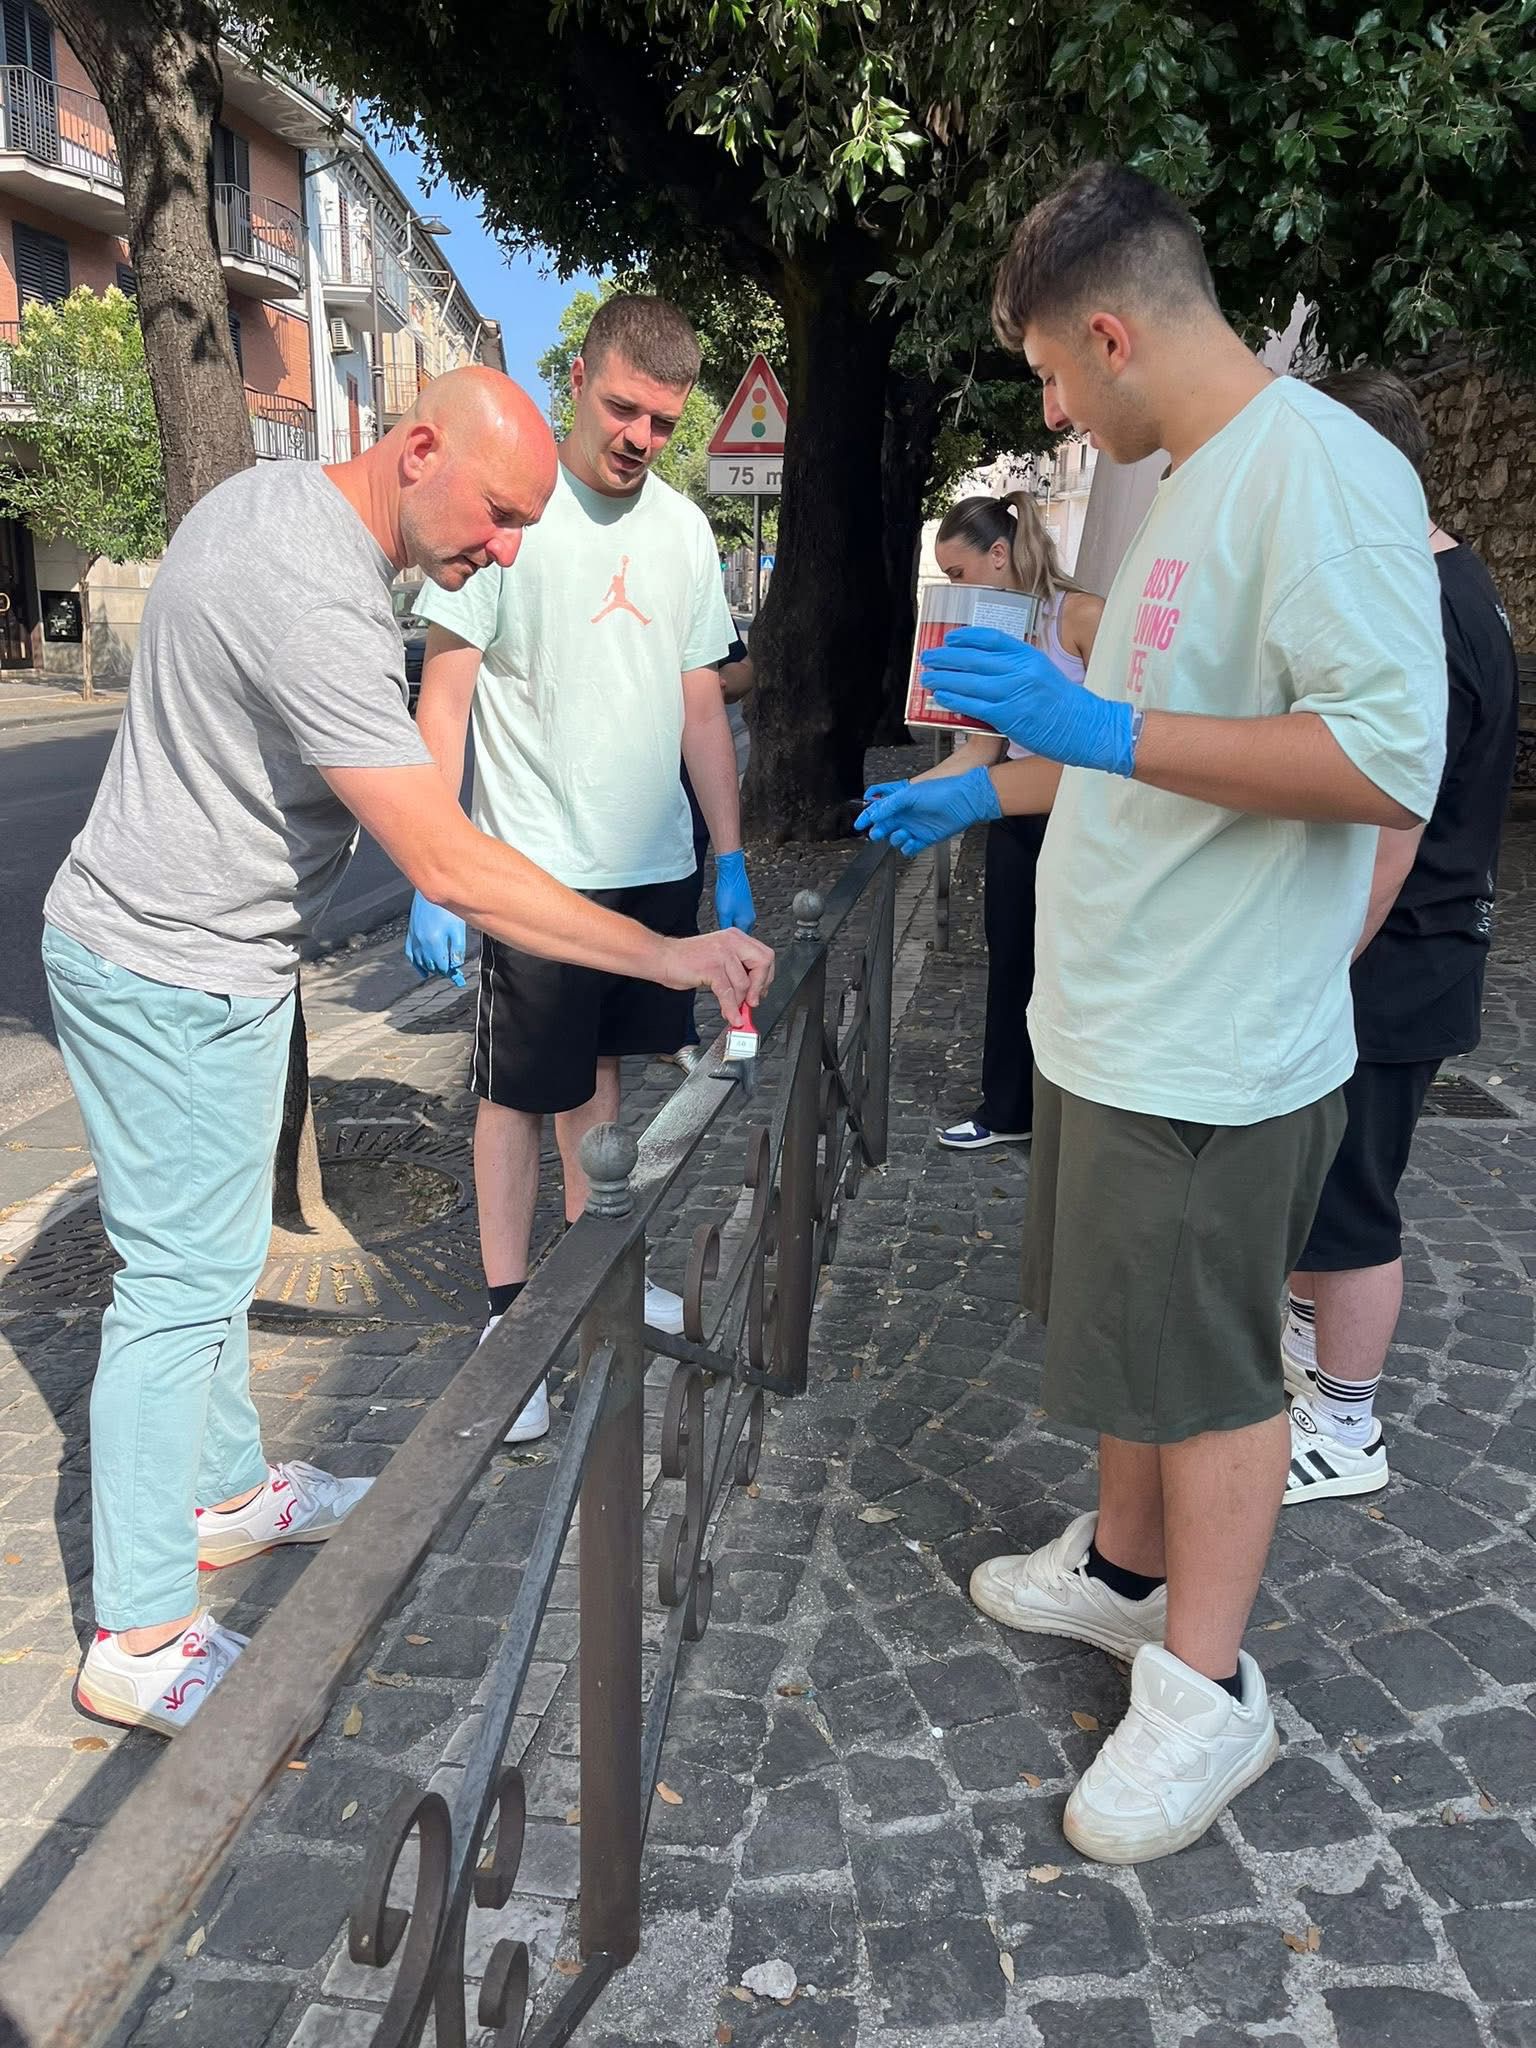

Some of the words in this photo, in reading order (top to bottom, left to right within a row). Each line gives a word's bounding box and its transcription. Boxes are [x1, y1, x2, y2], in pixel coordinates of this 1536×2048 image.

[728, 466, 754, 485] 75
[766, 471, 783, 485] m
[1142, 558, 1190, 602] BUSY
